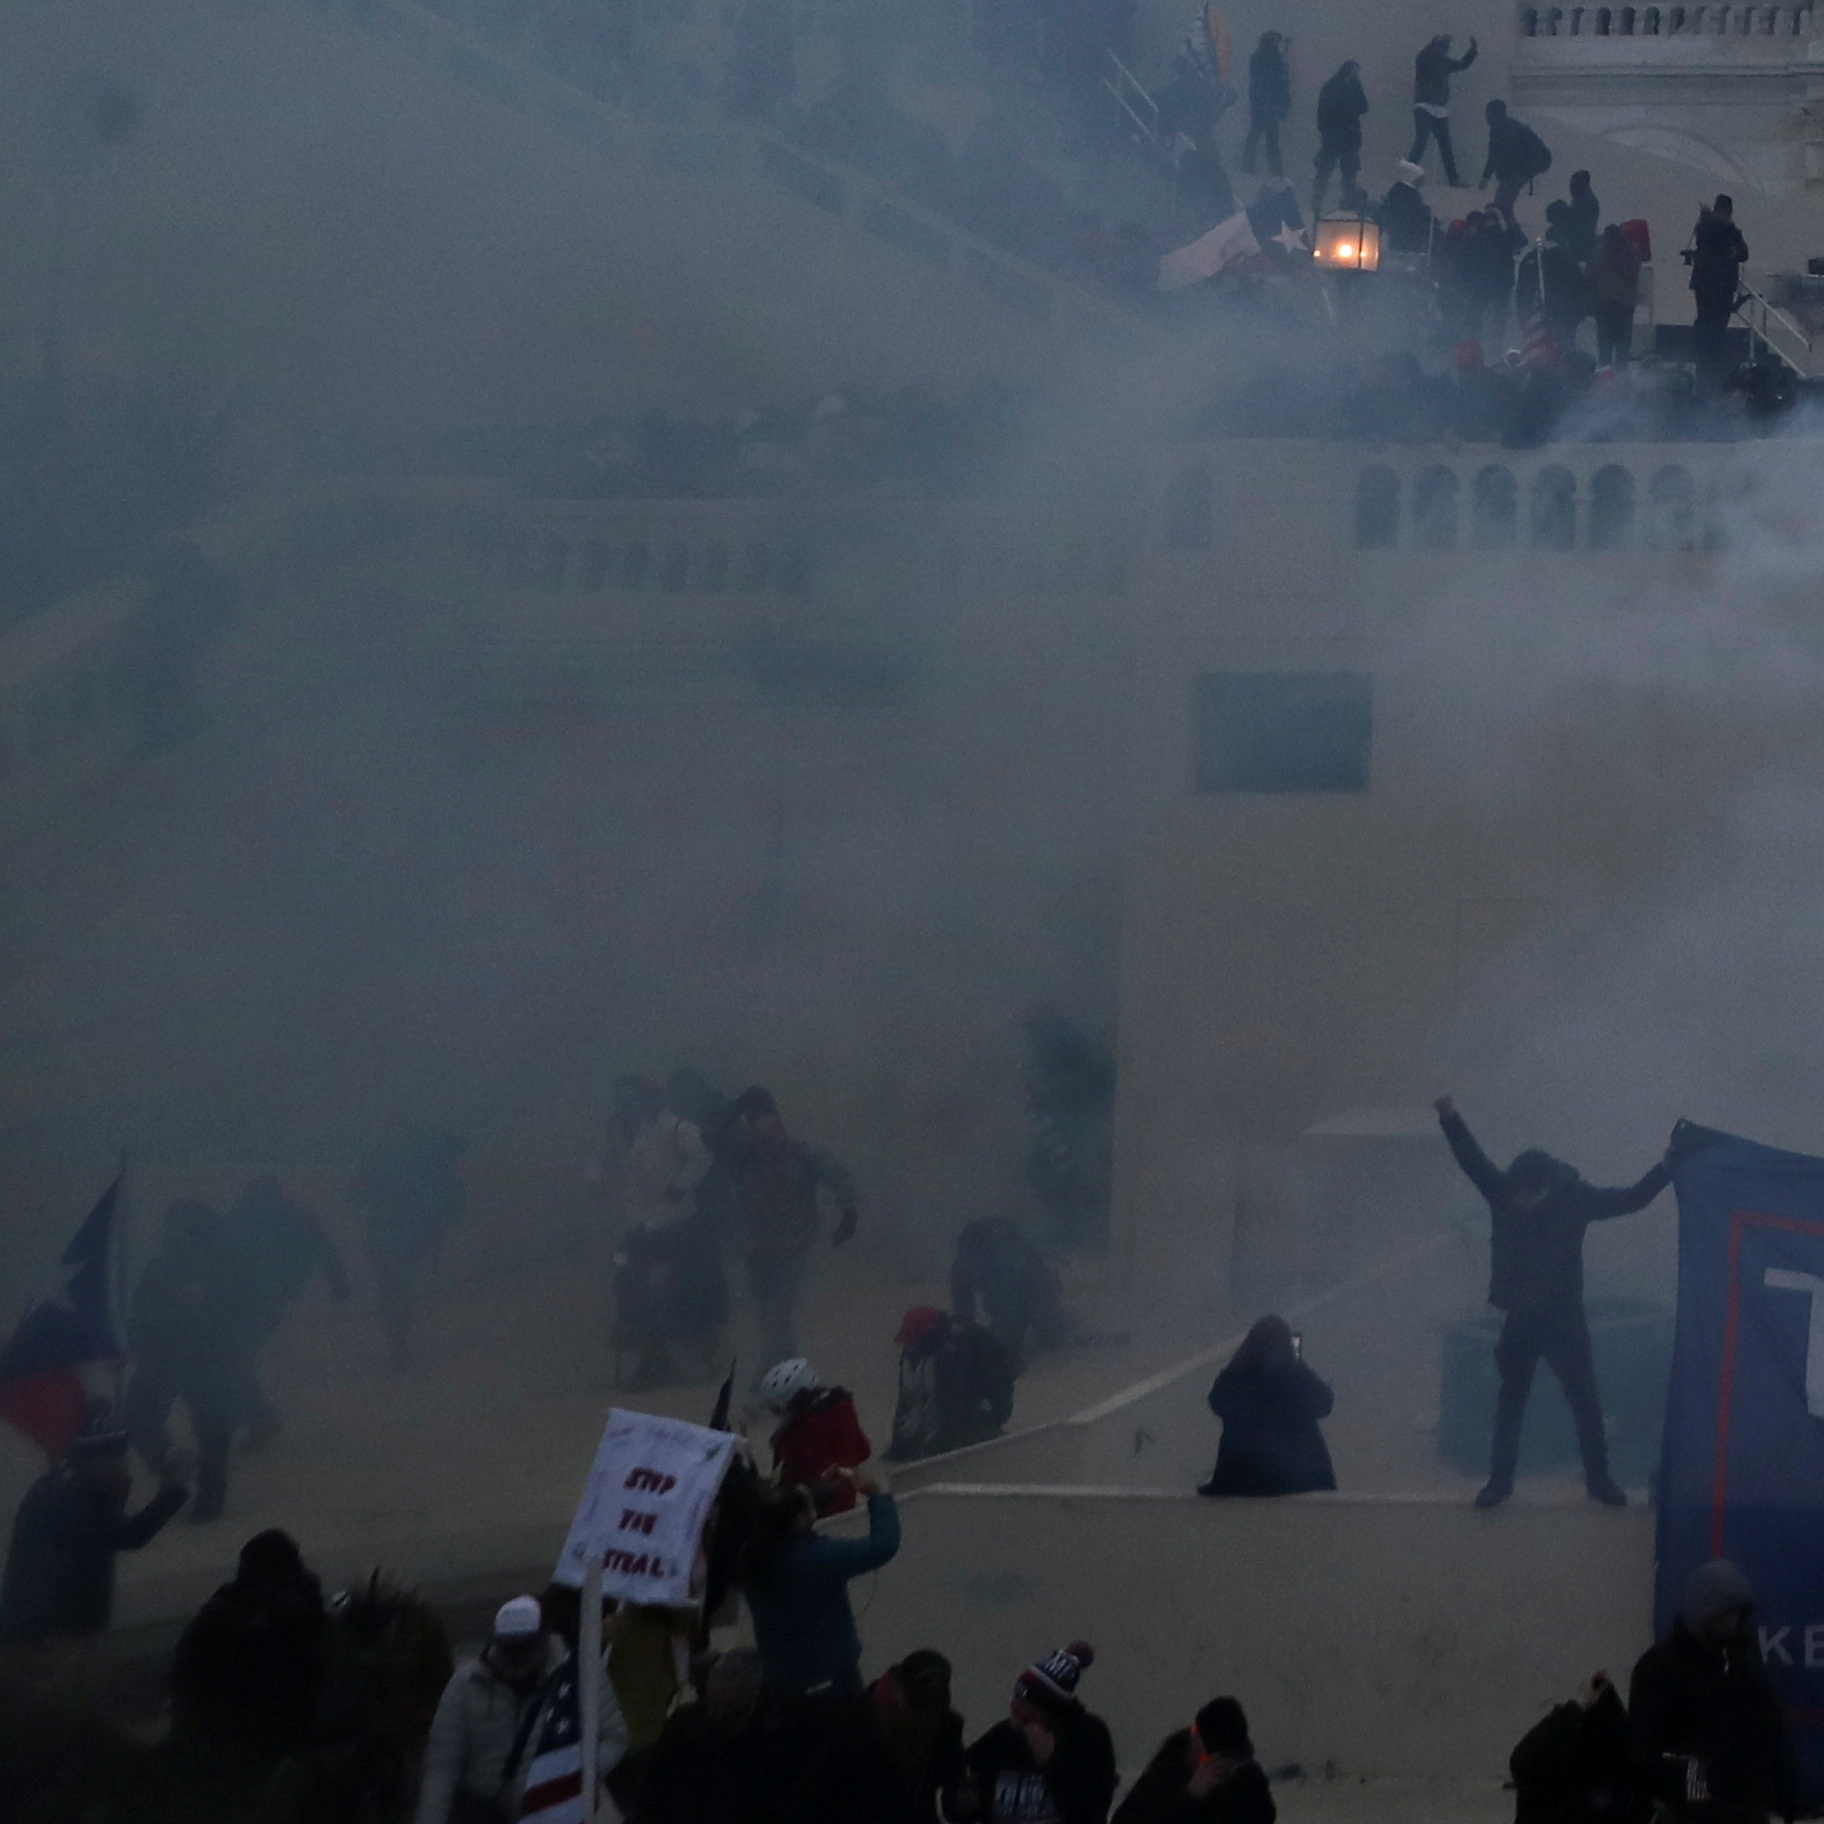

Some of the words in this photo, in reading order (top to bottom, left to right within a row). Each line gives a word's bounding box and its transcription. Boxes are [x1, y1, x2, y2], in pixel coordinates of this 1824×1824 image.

[625, 1469, 676, 1494] STOP
[619, 1509, 657, 1534] THE
[603, 1549, 664, 1577] STEAL
